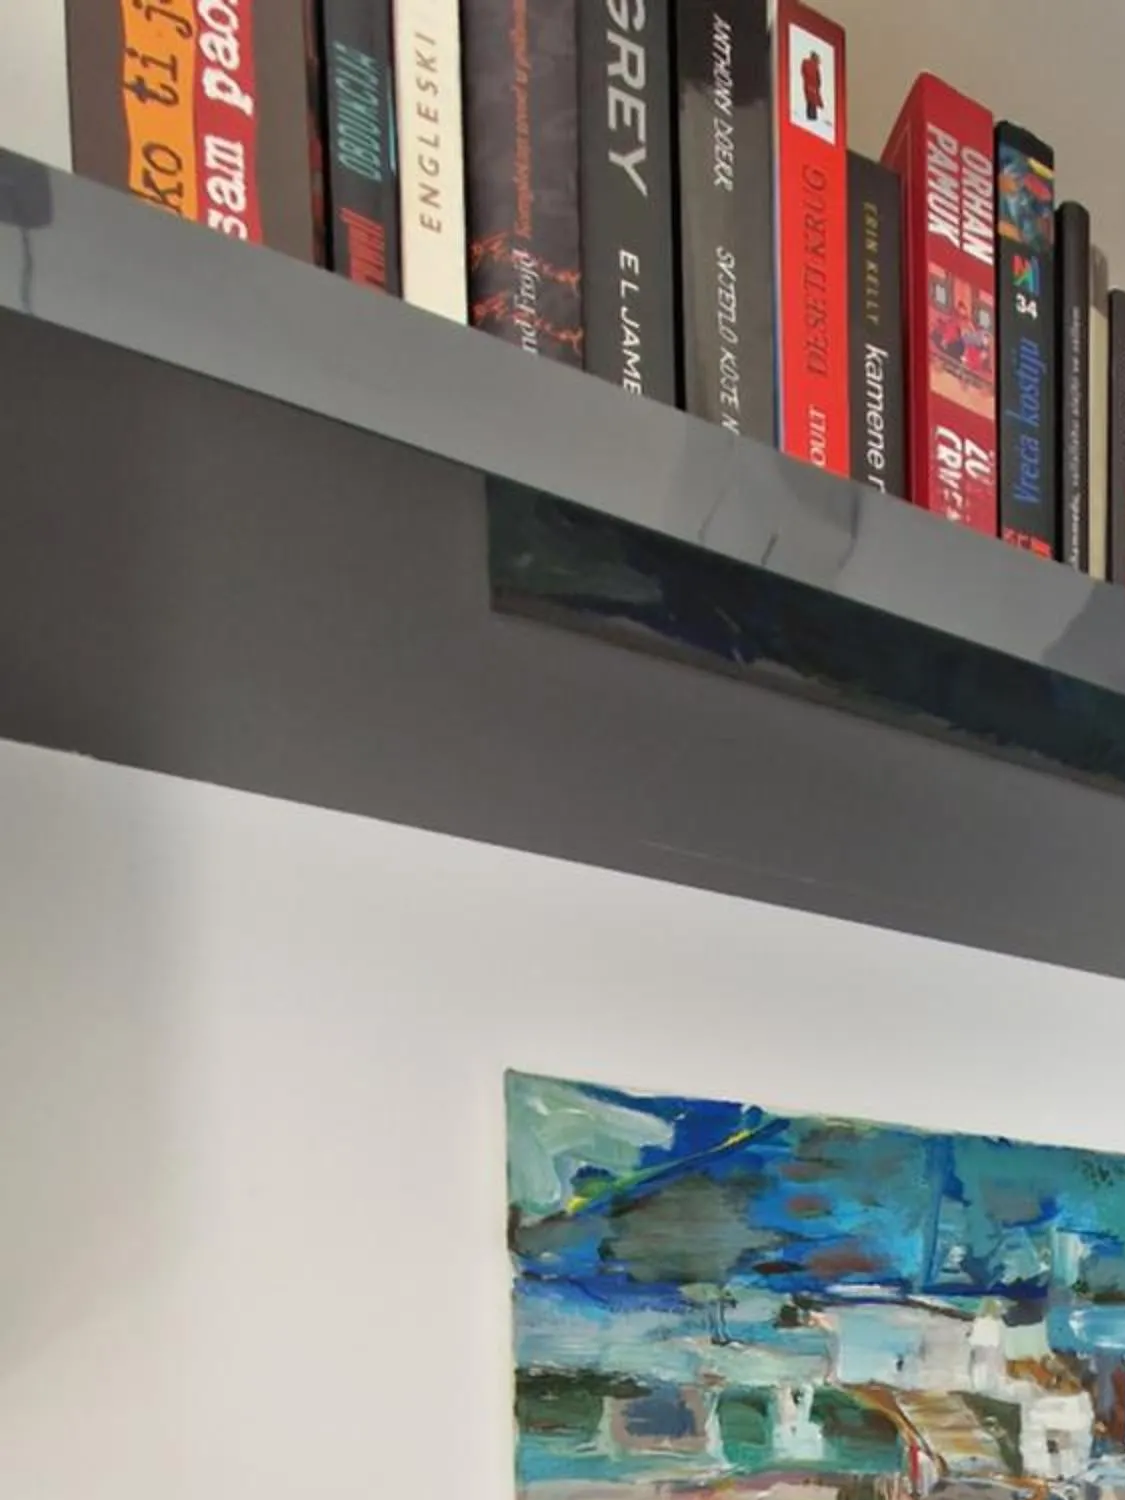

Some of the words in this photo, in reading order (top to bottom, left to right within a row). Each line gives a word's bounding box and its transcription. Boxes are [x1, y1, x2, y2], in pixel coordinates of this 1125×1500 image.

[132, 0, 193, 38] j
[197, 0, 254, 116] pao
[713, 12, 734, 116] ANTHONY
[123, 48, 179, 107] ti
[333, 41, 382, 182] OBDUKCIJA
[414, 32, 443, 234] ENGLESKI
[714, 117, 735, 192] DOERR
[204, 134, 248, 241] sam
[802, 164, 827, 262] KRUG
[863, 201, 879, 253] ERIN
[926, 121, 961, 250] PAMUK
[960, 147, 993, 266] ORHAN
[512, 248, 540, 314] Frojd
[618, 249, 640, 275] E
[620, 279, 640, 299] L
[715, 246, 739, 345] SVJETLO
[866, 259, 880, 326] KELLY
[1015, 292, 1038, 320] 34
[621, 305, 642, 396] JAME
[804, 262, 828, 378] DESETI
[719, 347, 740, 411] KOJE
[864, 343, 889, 470] kamene
[1004, 336, 1046, 428] kostiju
